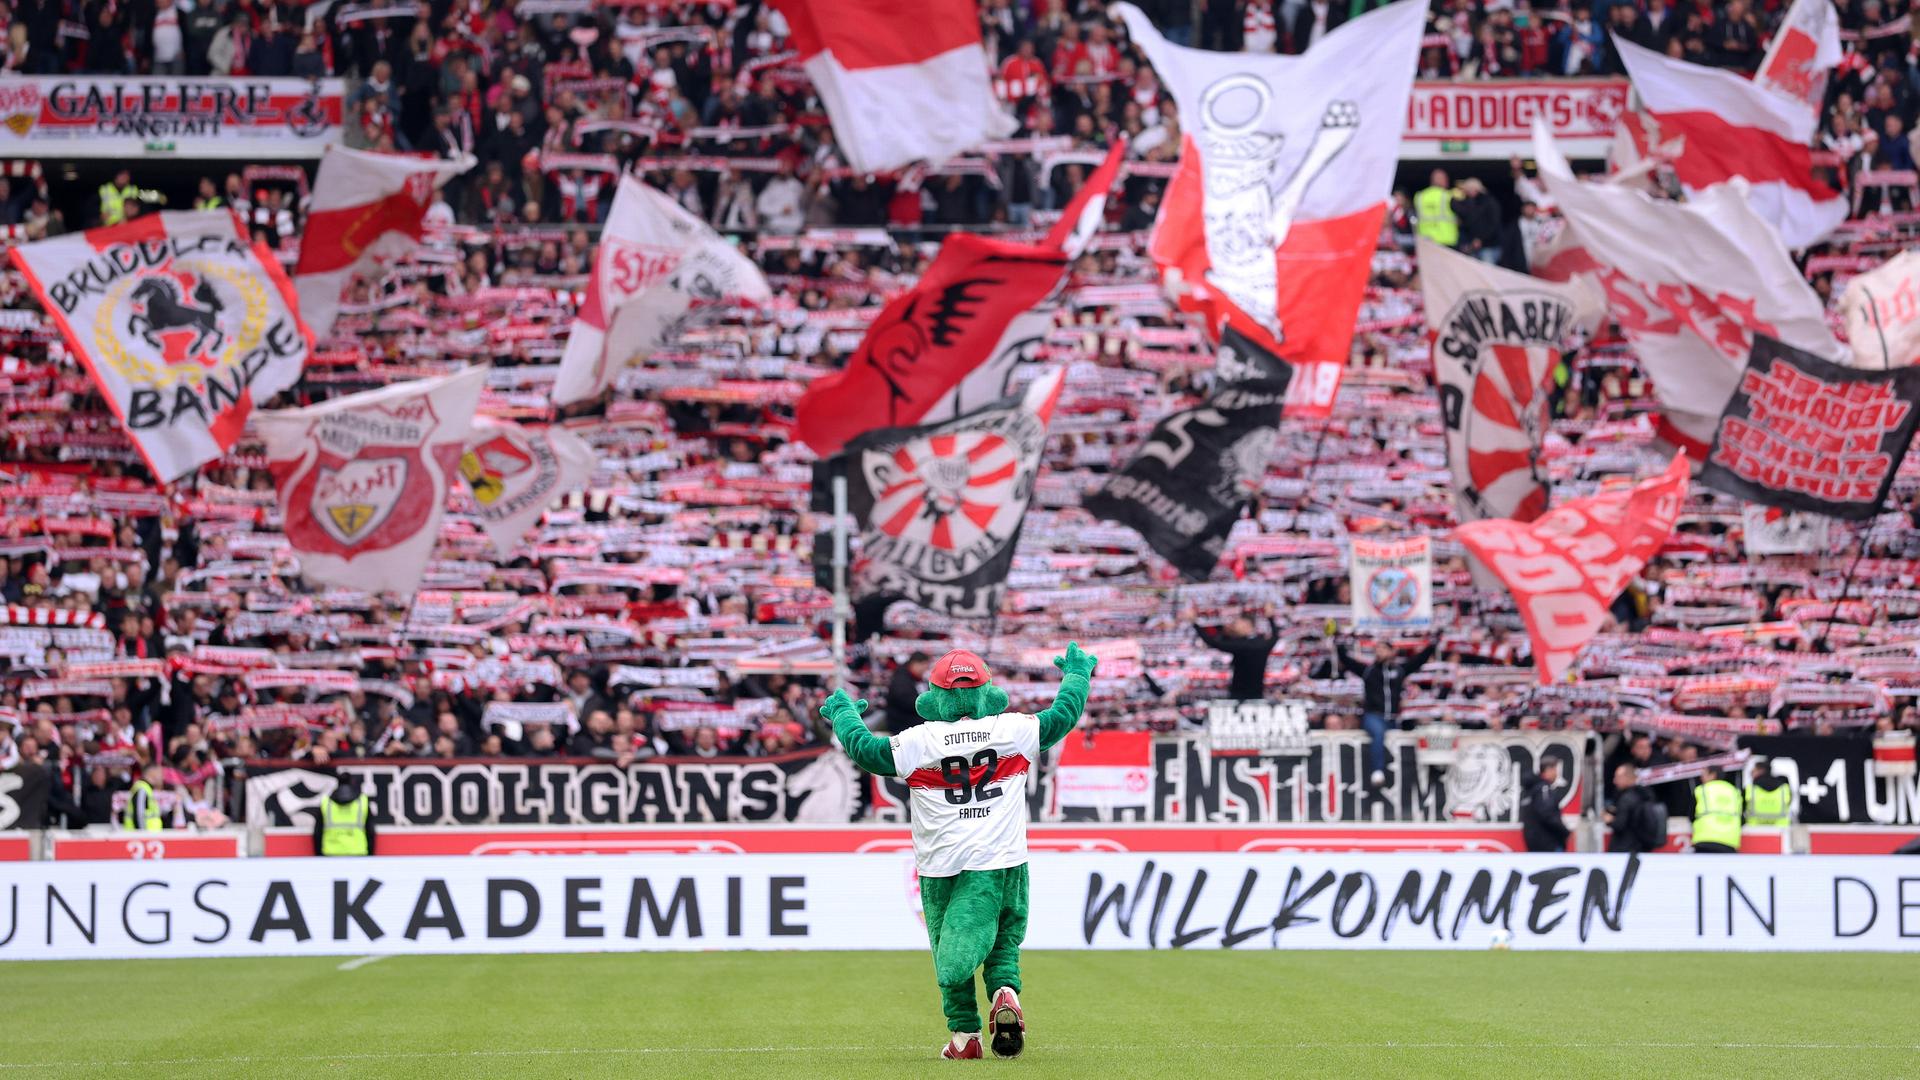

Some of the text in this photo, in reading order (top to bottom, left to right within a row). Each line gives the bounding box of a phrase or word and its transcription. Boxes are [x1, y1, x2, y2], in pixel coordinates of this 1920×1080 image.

[50, 81, 273, 121] GALEERE
[1430, 95, 1571, 128] ADDICTS
[126, 316, 303, 429] BANDE
[944, 731, 991, 746] STUTTGART
[340, 766, 784, 825] HOOLIGANS
[941, 748, 1003, 805] 92
[1083, 853, 1640, 948] WILLKOMMEN
[1697, 876, 1775, 936] IN
